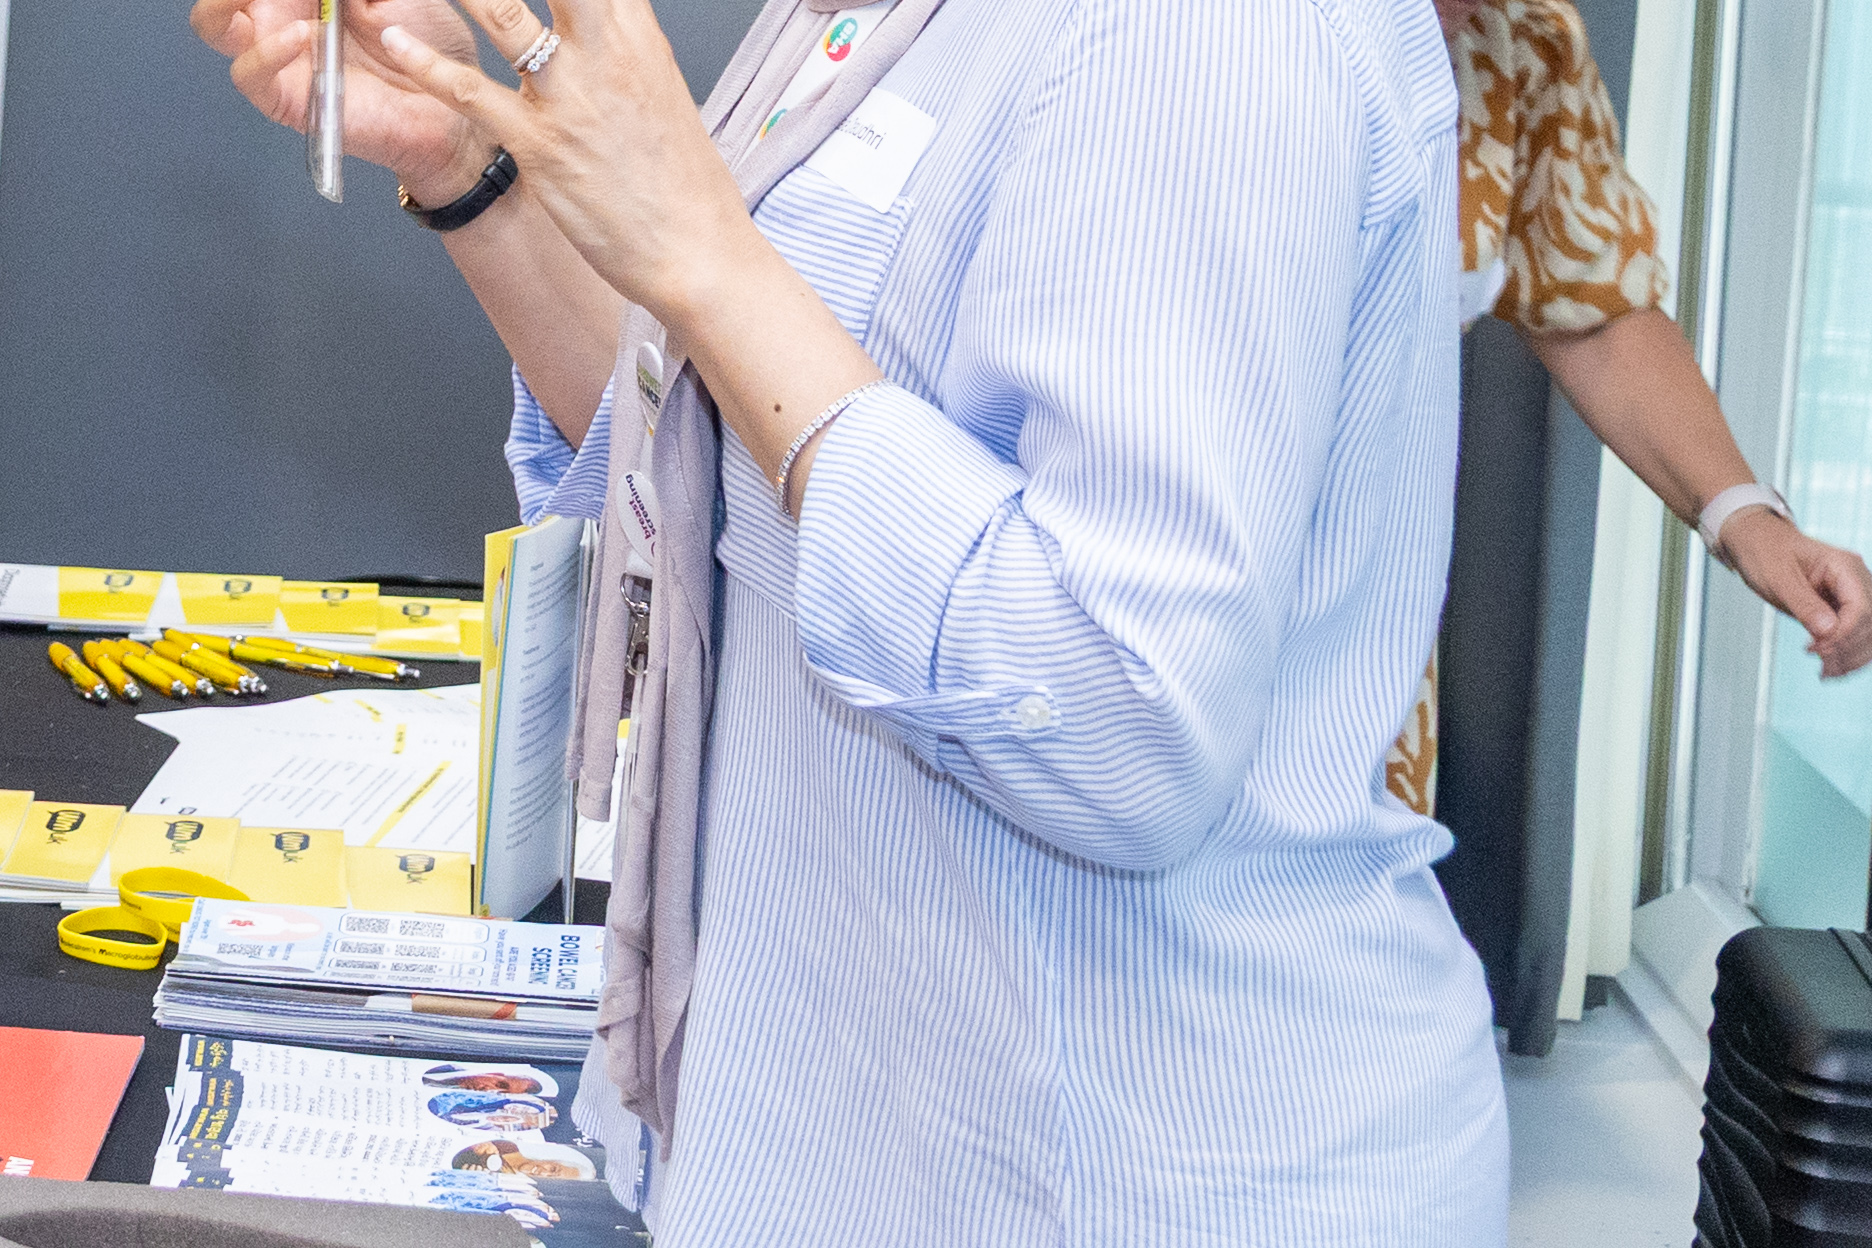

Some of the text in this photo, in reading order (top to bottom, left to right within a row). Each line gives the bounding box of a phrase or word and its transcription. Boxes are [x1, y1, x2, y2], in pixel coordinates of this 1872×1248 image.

[625, 473, 657, 535] screening
[628, 499, 651, 541] breast
[528, 947, 552, 985] SCREENING
[555, 934, 580, 990] BOWEL CANCER
